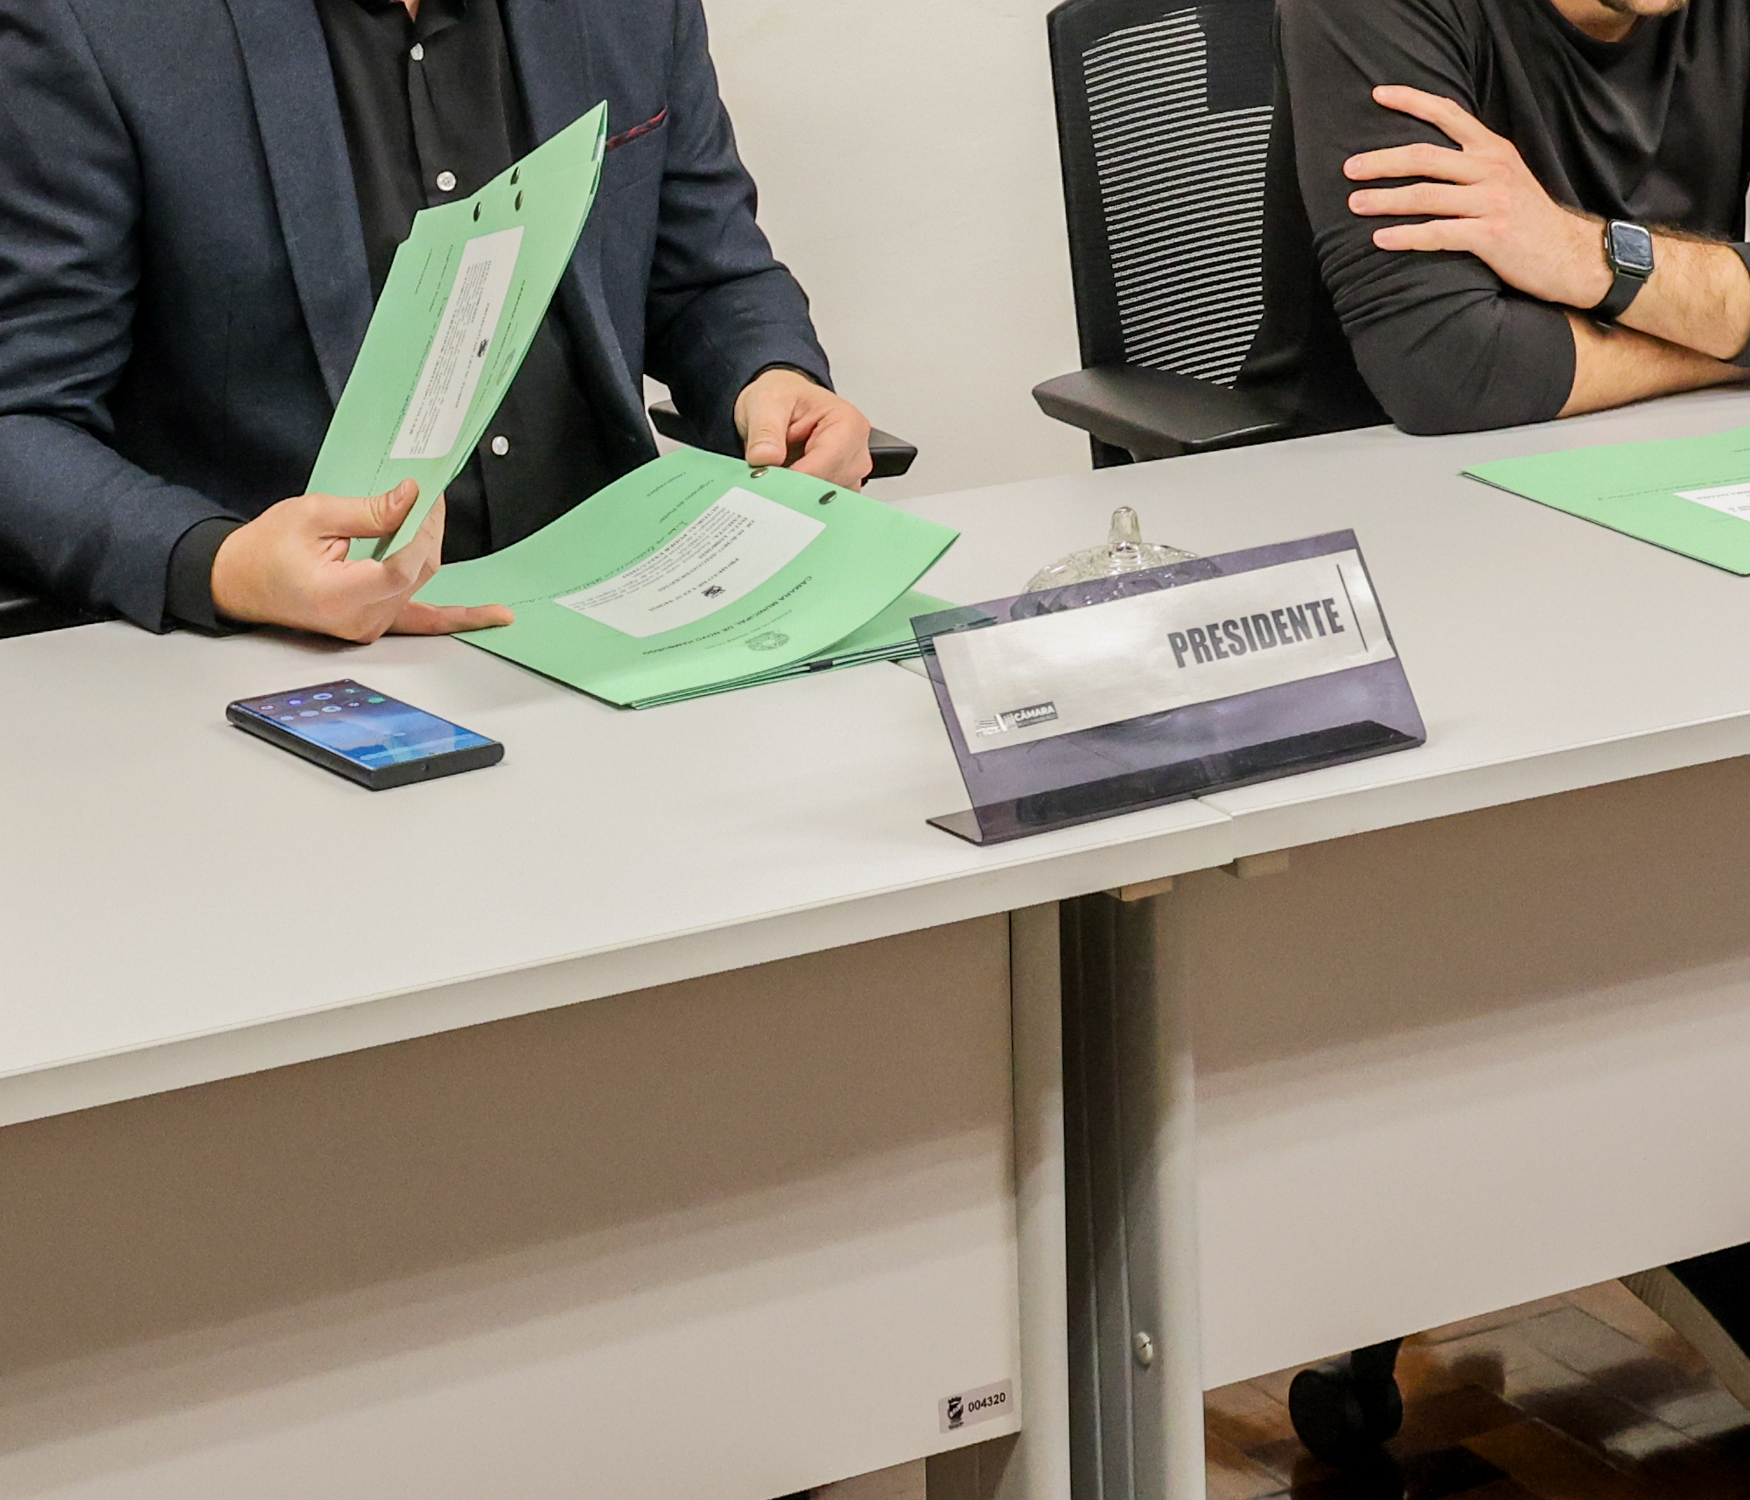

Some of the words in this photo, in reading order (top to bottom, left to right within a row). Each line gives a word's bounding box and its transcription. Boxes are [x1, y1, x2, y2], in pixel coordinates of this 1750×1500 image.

[1167, 597, 1345, 669] PRESIDENTE
[1014, 704, 1056, 722] CÂMARA
[968, 1392, 1007, 1412] 004320
